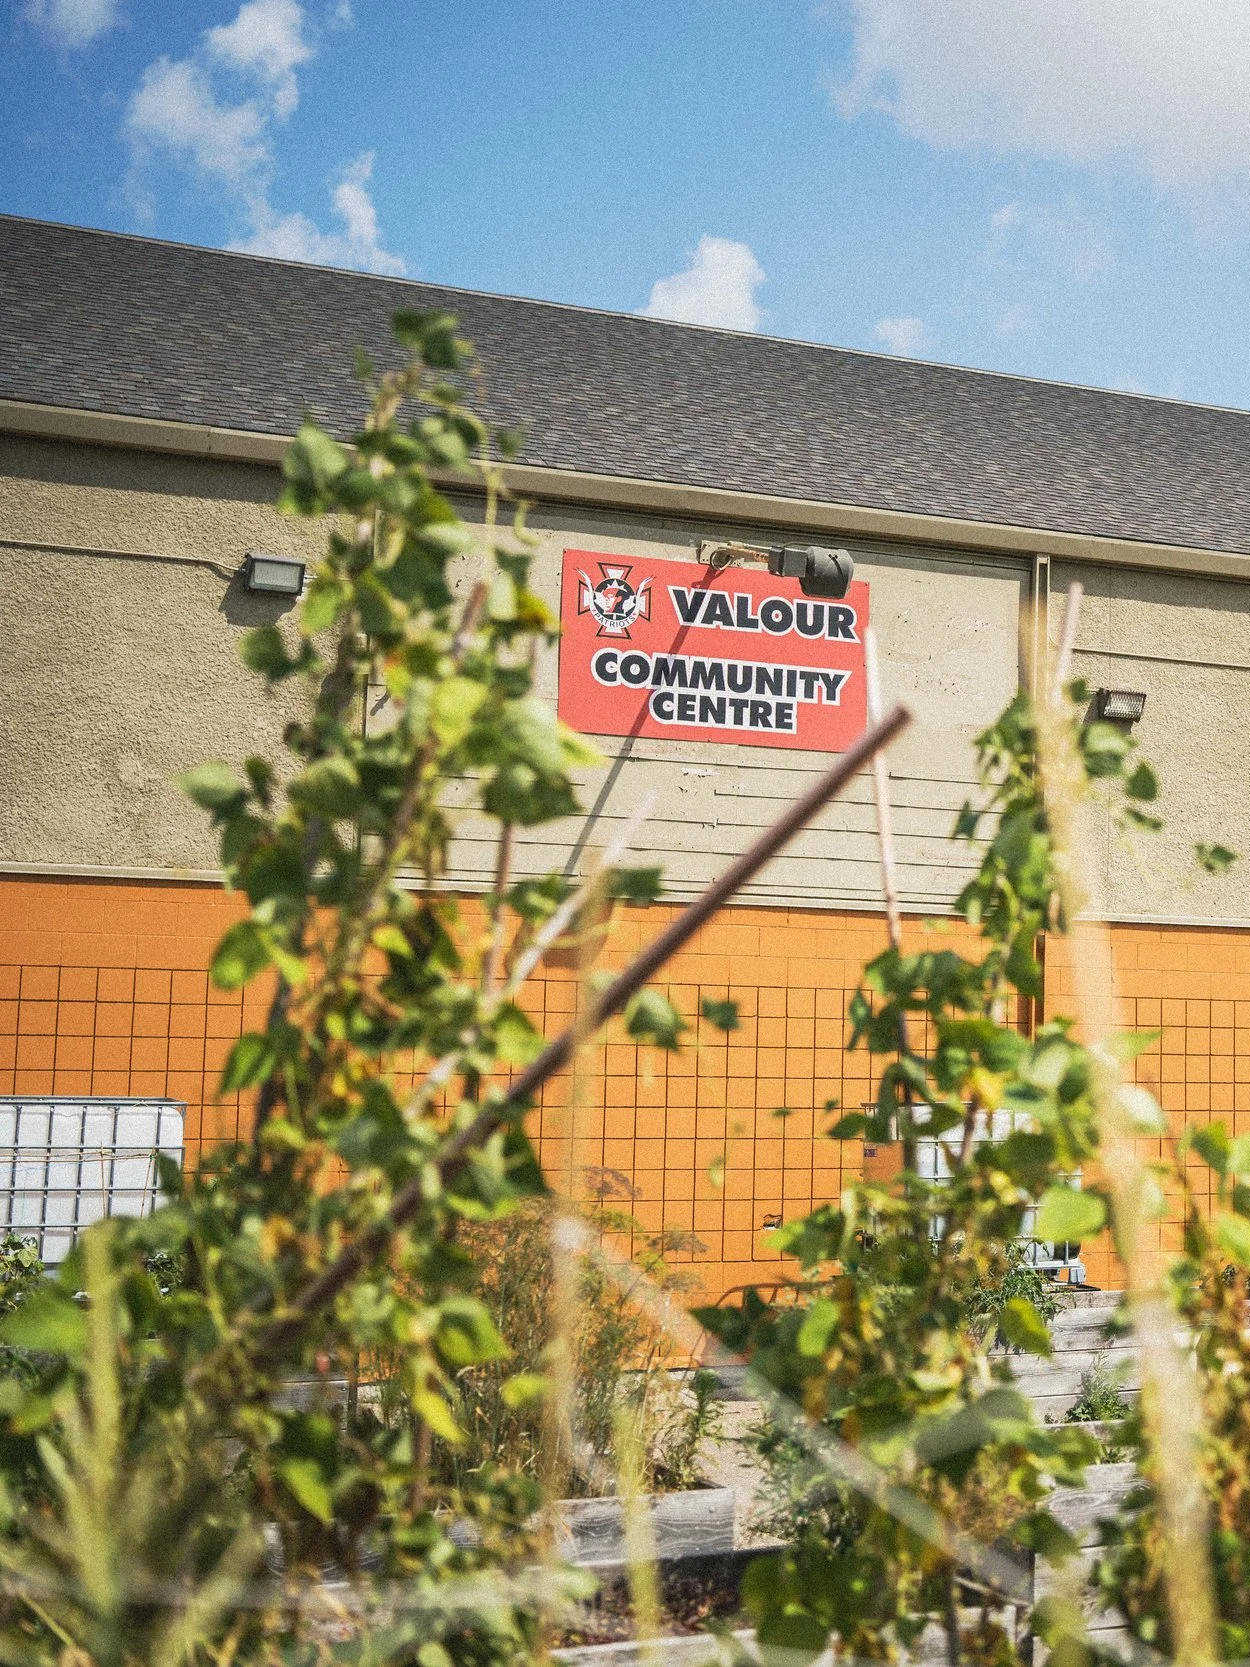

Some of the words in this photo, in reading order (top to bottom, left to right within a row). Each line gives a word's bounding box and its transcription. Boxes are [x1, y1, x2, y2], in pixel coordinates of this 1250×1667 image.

[593, 612, 636, 628] PATRIOTS
[670, 587, 858, 641] VALOUR
[593, 650, 851, 703] COMMUNITY
[650, 691, 795, 732] CENTRE
